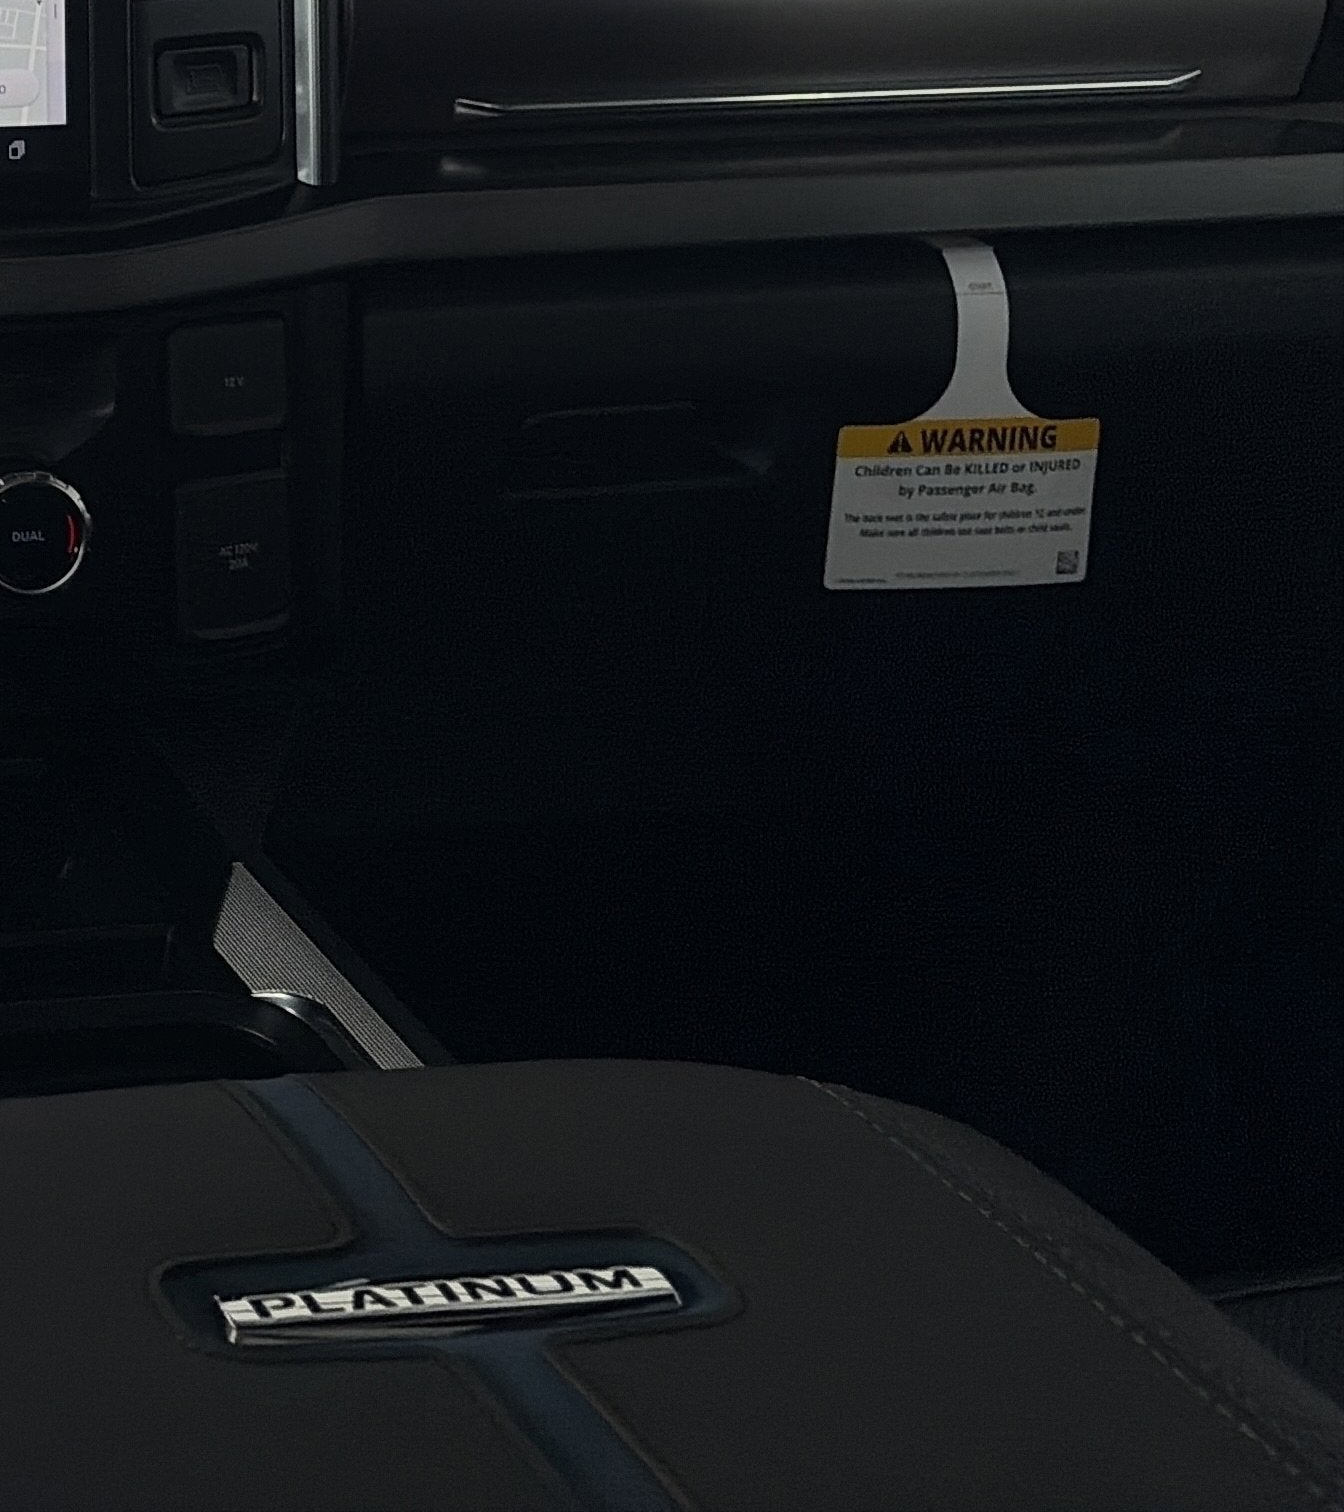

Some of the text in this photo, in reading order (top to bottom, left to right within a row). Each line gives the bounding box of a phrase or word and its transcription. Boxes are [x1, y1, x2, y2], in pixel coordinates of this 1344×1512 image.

[921, 425, 1058, 454] WARNING
[855, 459, 1081, 478] Children Can Be KILLED or INJURED
[898, 485, 913, 499] by
[918, 484, 984, 498] Passenger
[988, 482, 1006, 494] Air
[12, 530, 46, 542] DUAL
[248, 1269, 644, 1318] PLATINUM
